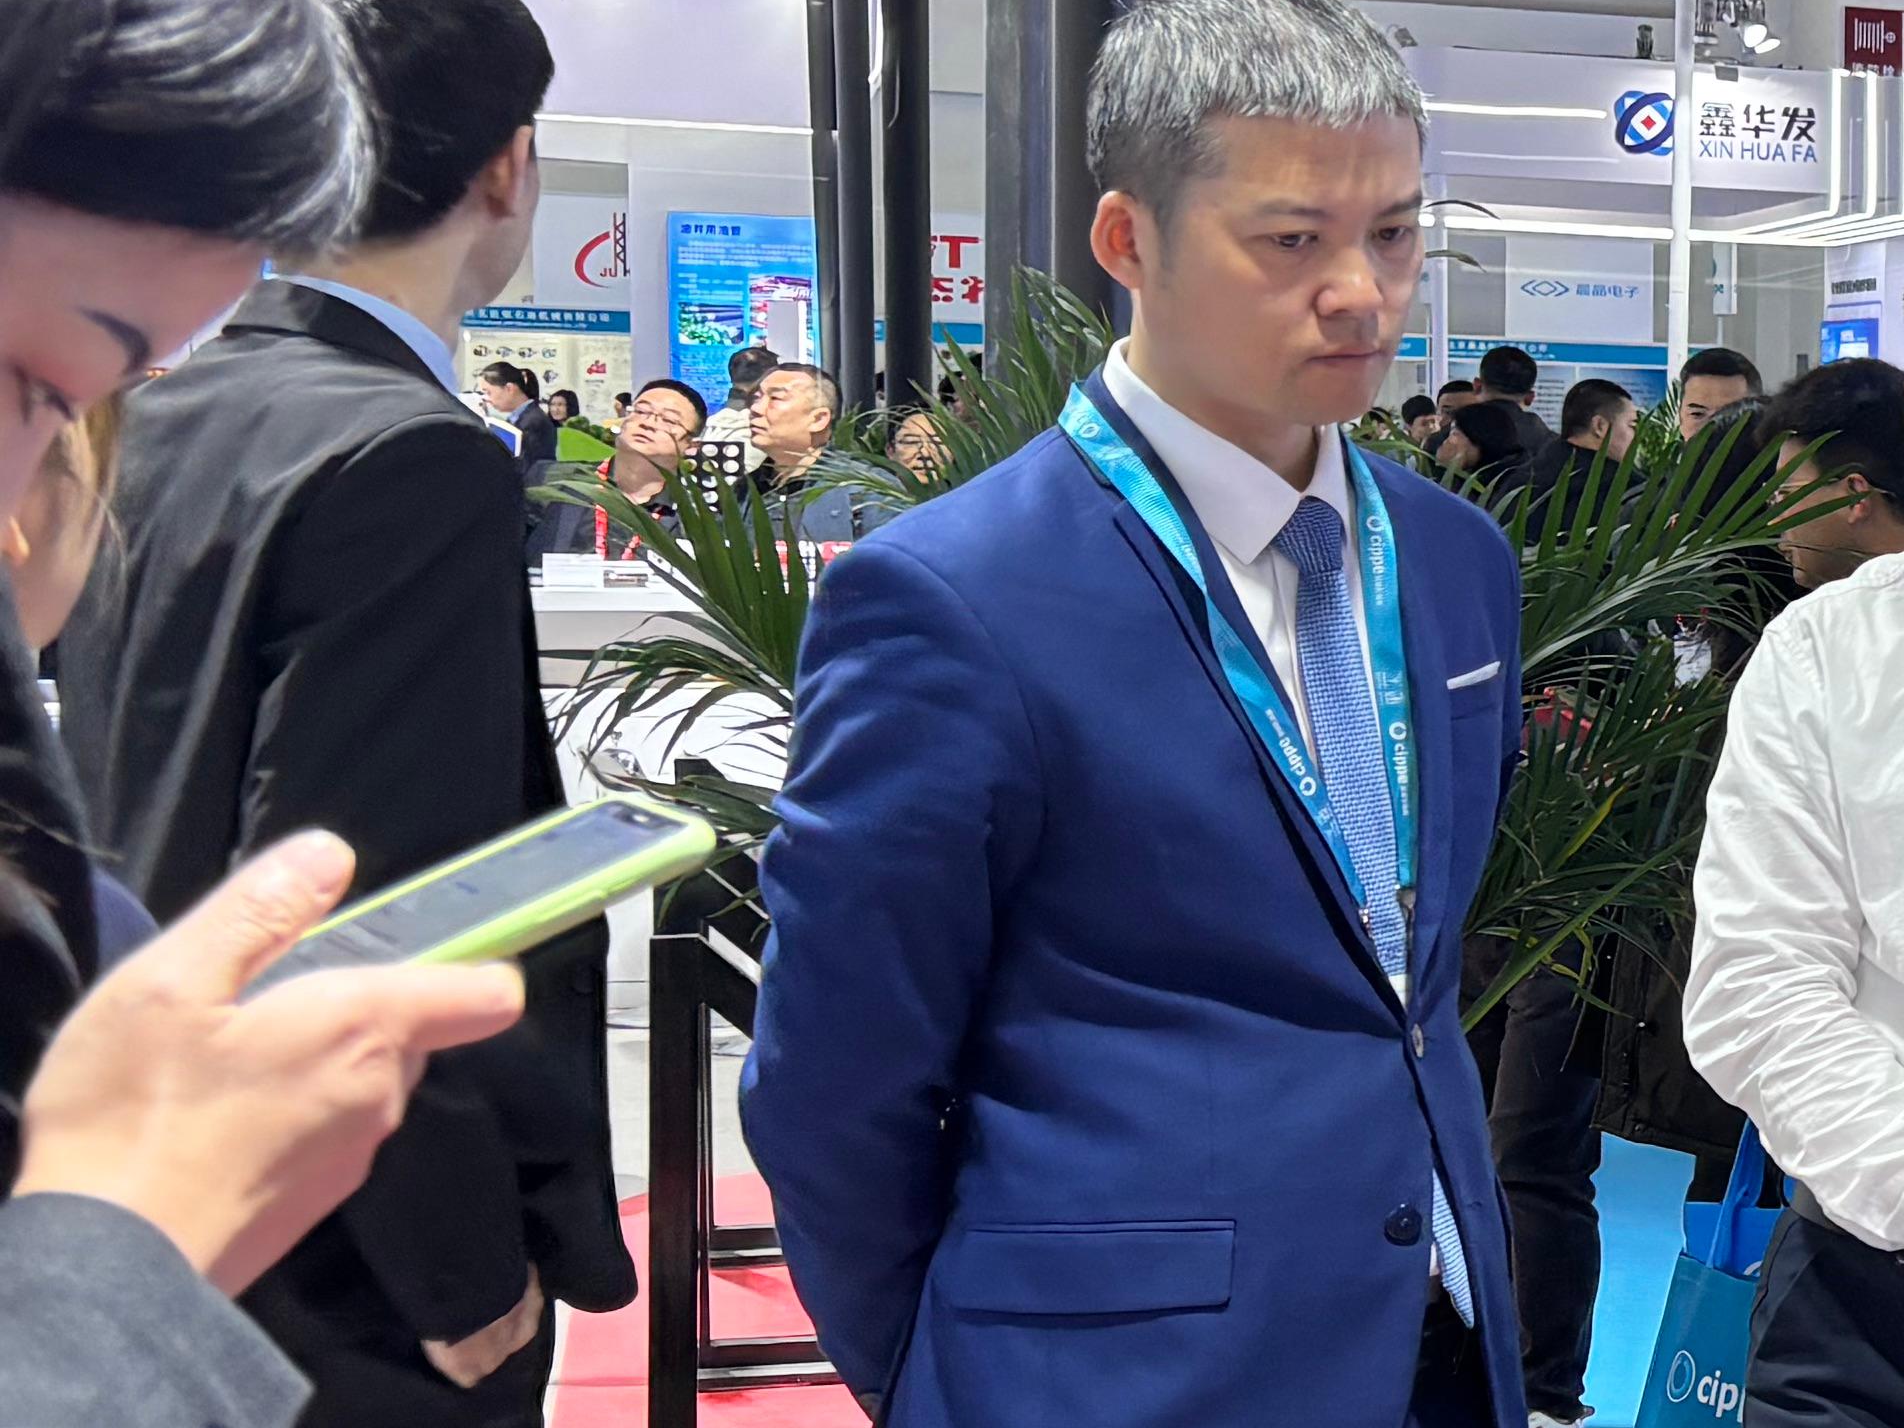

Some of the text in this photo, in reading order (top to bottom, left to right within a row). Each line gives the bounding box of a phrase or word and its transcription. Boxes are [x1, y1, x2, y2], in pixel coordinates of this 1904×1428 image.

[1699, 101, 1817, 143] 鑫华发
[1699, 139, 1819, 164] XIN HUA FA
[1279, 737, 1306, 776] cippe
